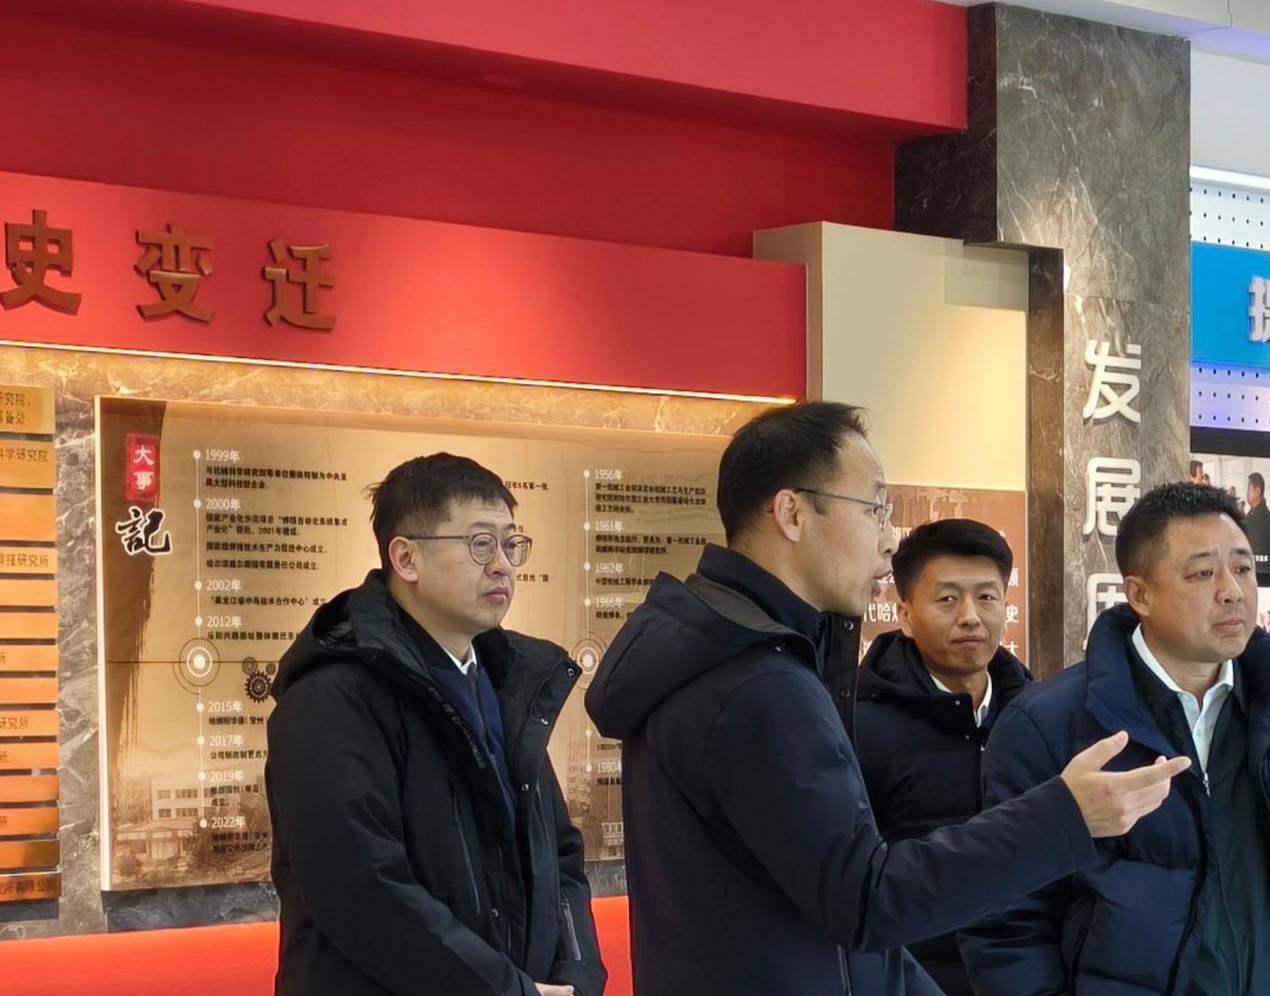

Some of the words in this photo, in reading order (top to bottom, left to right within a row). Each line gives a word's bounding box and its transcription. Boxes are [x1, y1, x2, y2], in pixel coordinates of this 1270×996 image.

[205, 449, 241, 463] 1999年
[205, 498, 241, 511] 2000年
[206, 579, 242, 593] 2002年
[207, 615, 242, 629] 2012年
[207, 700, 243, 713] 2015年
[209, 734, 244, 747] 2017年
[209, 770, 245, 783] 2019年
[211, 816, 246, 829] 2022年
